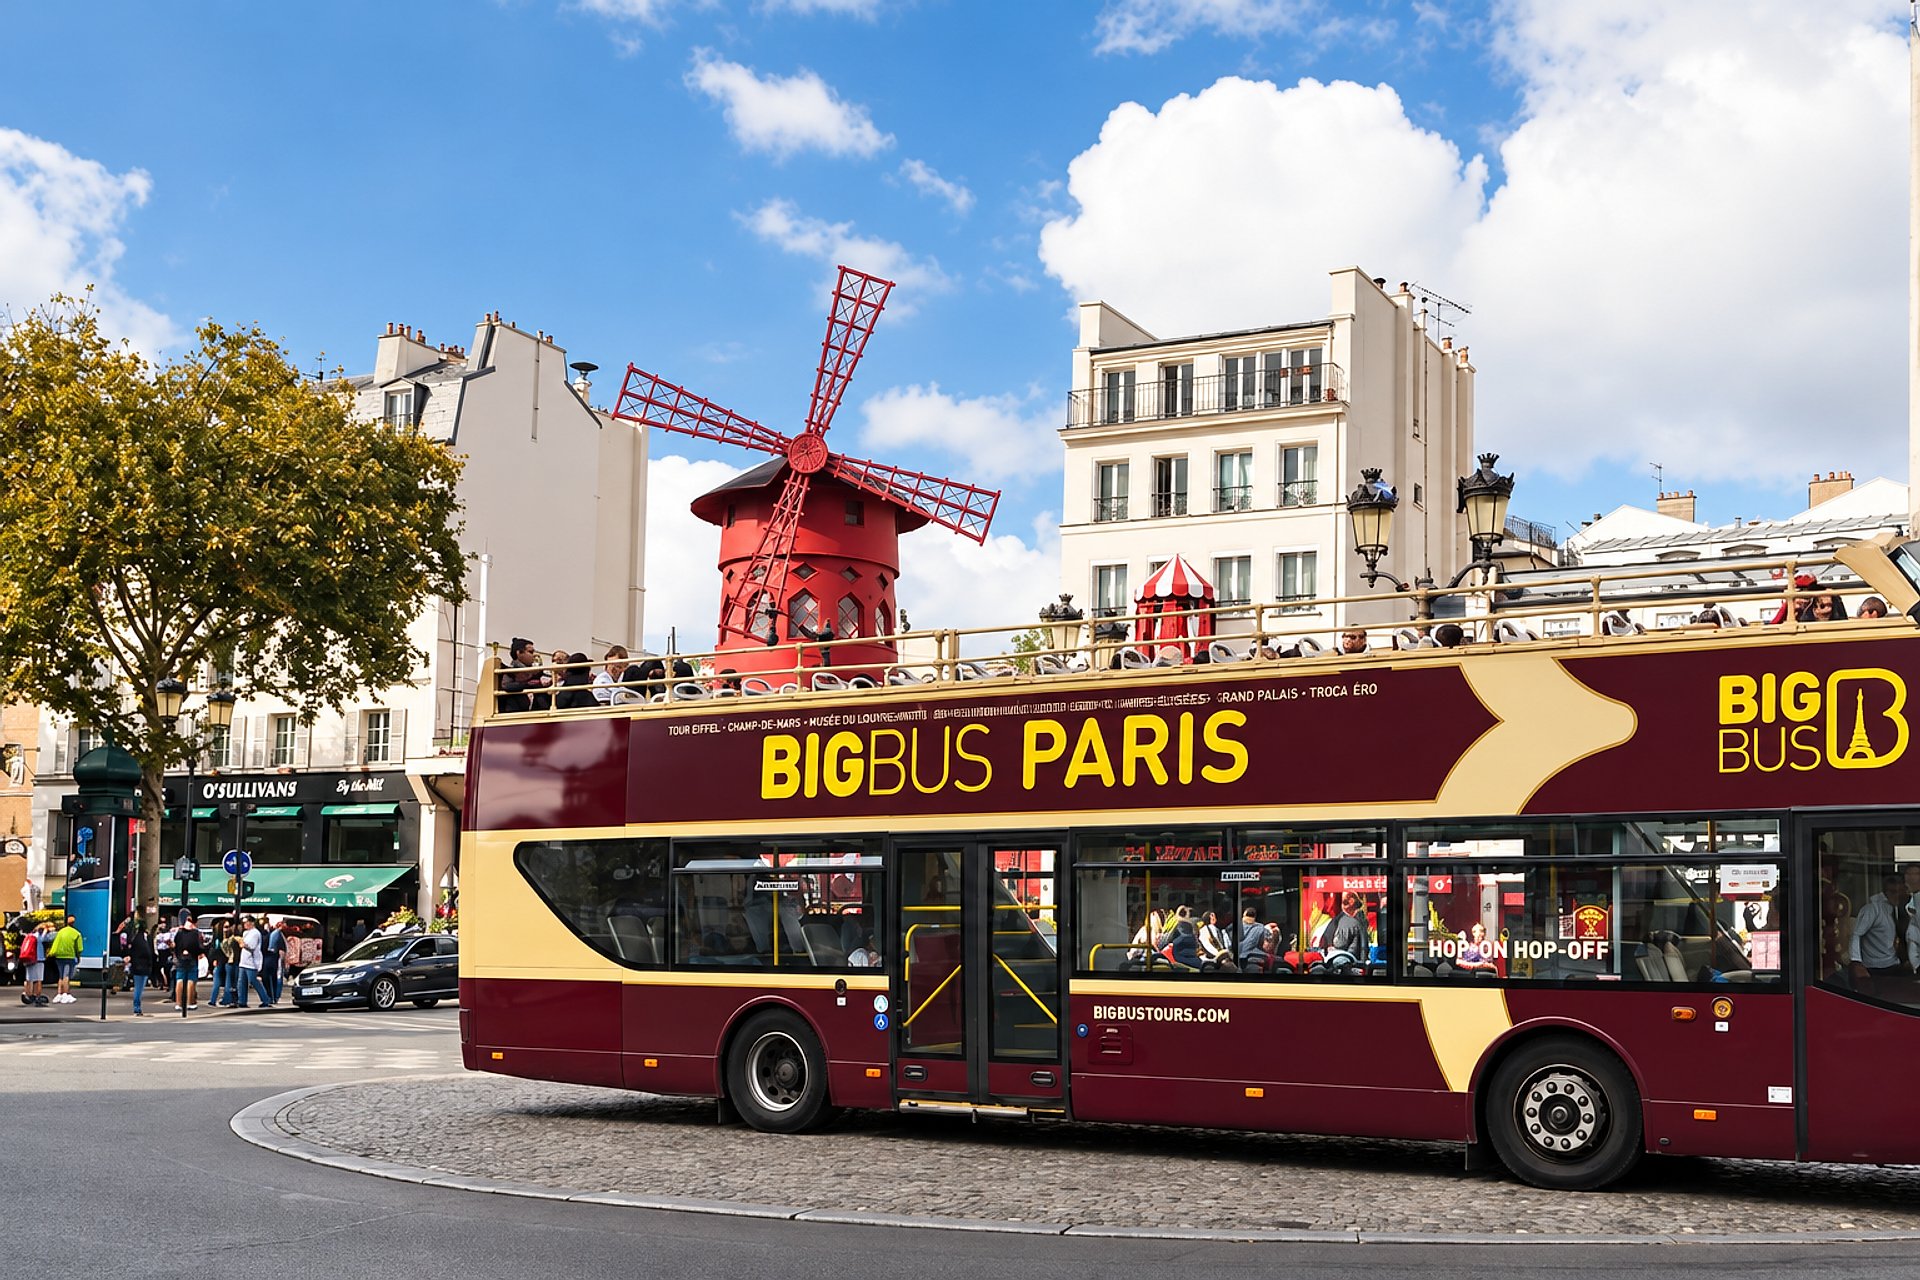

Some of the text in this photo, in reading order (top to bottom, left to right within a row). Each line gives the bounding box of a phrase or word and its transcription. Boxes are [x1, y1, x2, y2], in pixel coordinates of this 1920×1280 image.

[668, 725, 690, 736] TOUR
[692, 723, 721, 734] EIFFEL
[842, 714, 856, 725] DU
[1217, 691, 1254, 703] GRAND
[1257, 688, 1299, 701] PALAIS
[1719, 671, 1822, 725] BIG
[1022, 709, 1249, 790] PARIS
[1719, 725, 1822, 773] BUS
[202, 781, 298, 800] O'SULLIVANS
[1514, 941, 1609, 960] HOP-OFF
[1093, 1005, 1230, 1023] BIGBUSTOURS.COM
